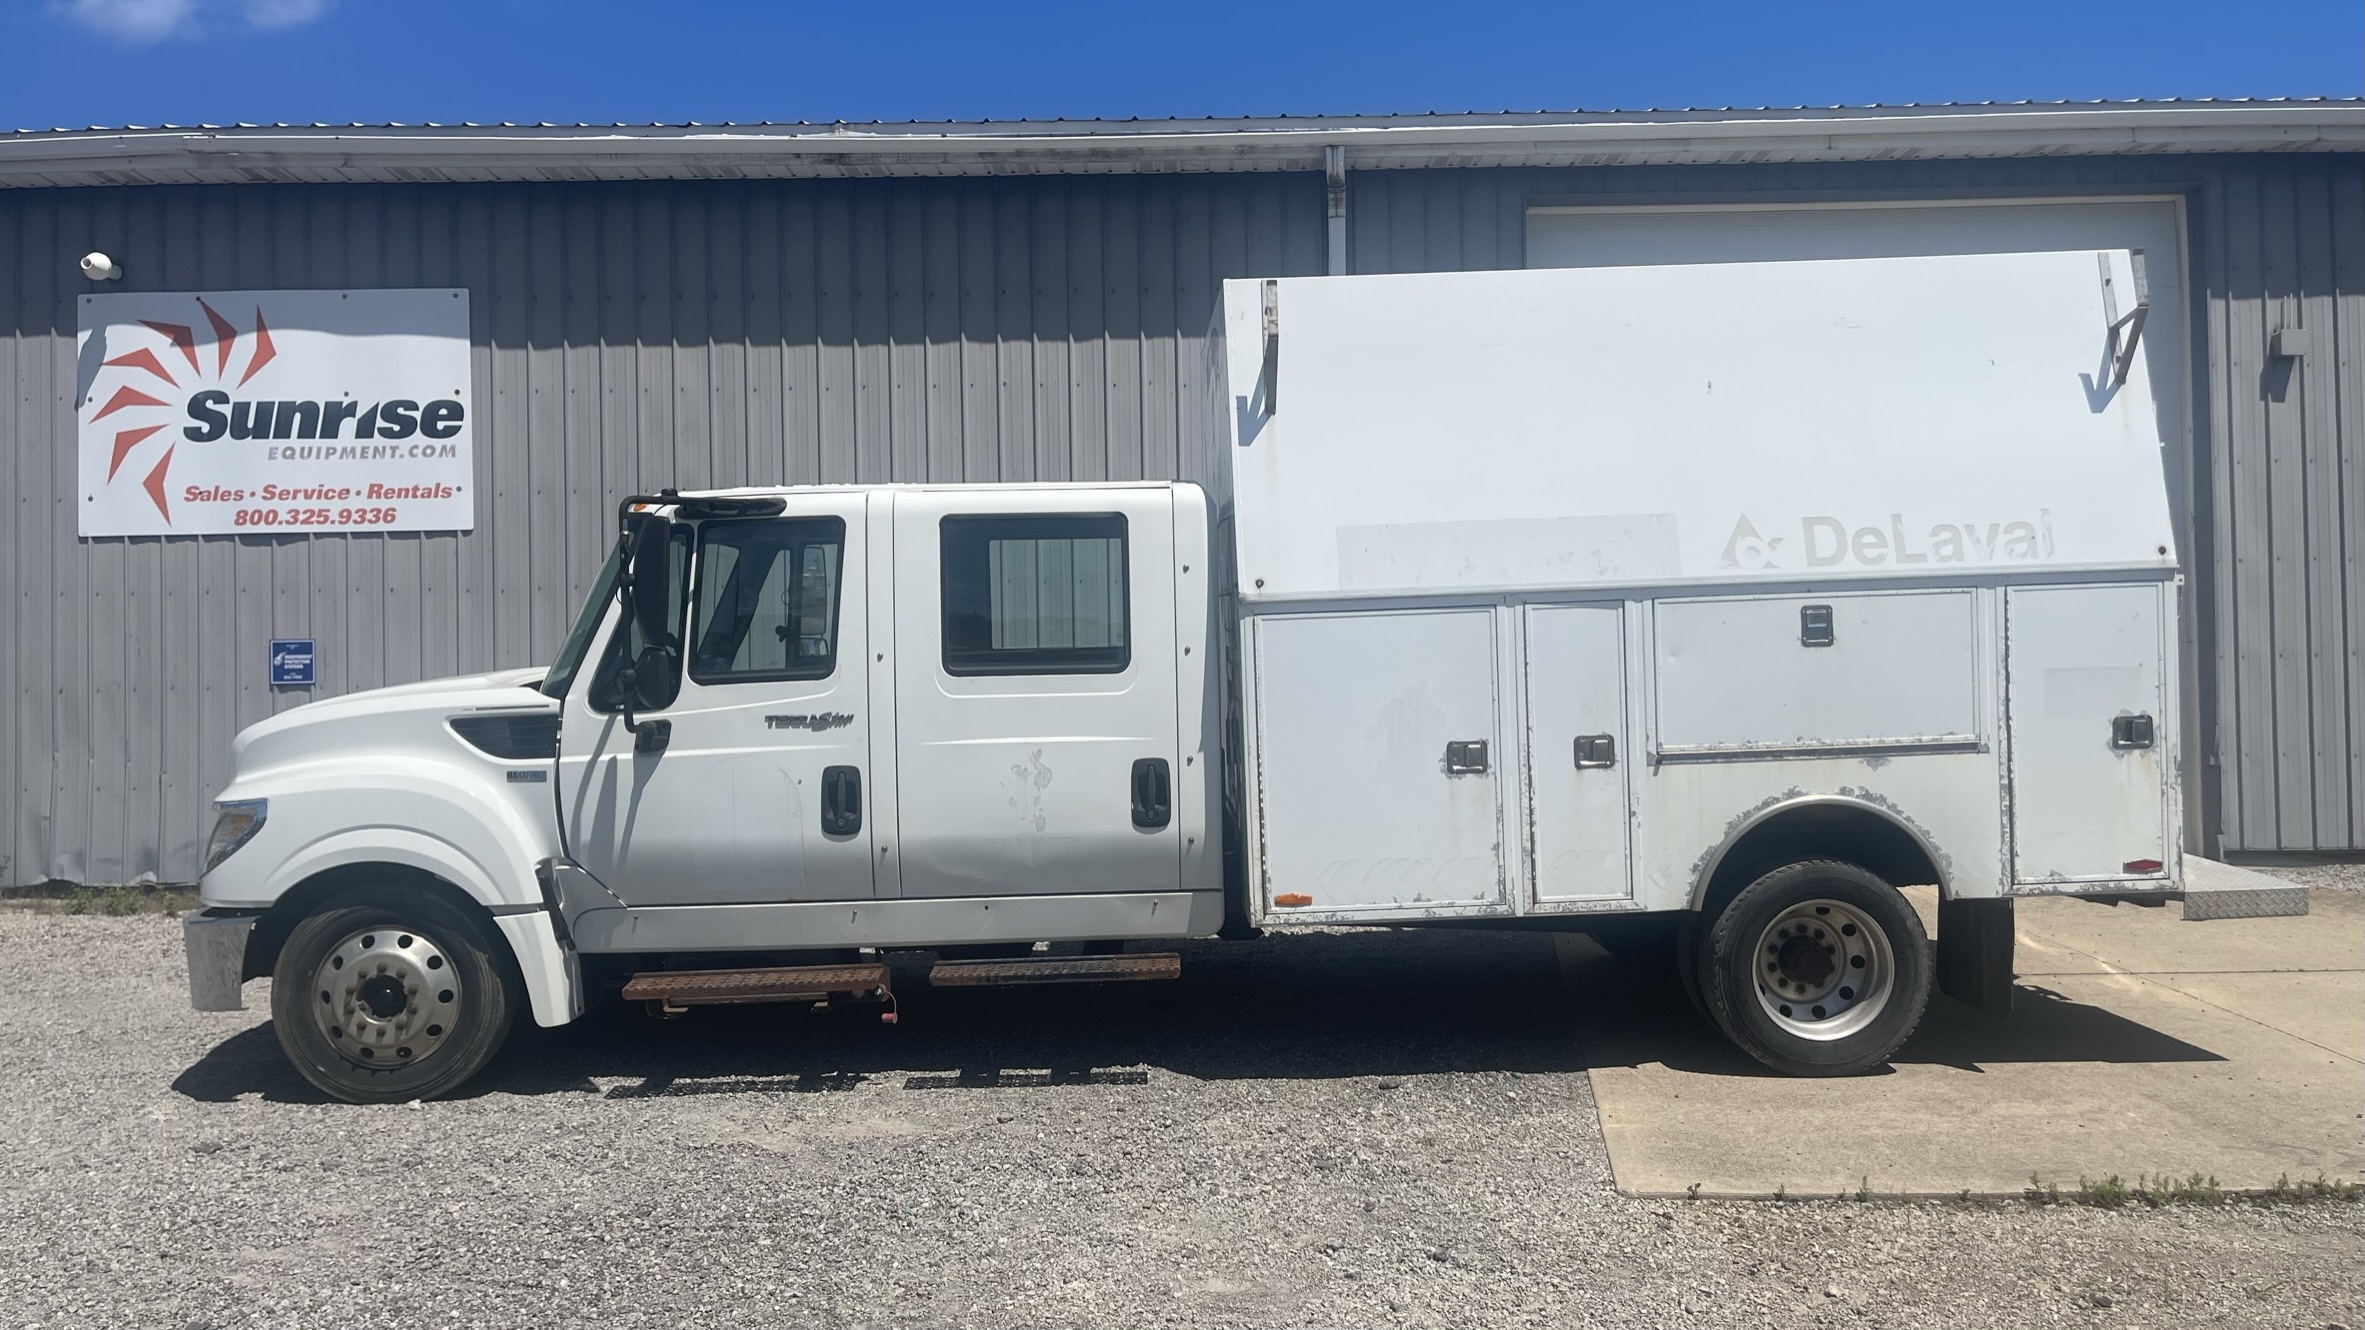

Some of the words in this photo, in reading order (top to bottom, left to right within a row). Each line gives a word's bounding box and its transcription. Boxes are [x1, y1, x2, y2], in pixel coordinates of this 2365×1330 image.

[183, 389, 464, 443] Sunrise
[267, 444, 457, 461] EQUIPMENT.COM
[184, 485, 245, 502] Sales
[261, 484, 350, 501] Service
[367, 482, 453, 500] Rentals
[233, 507, 397, 526] 800.325.9336
[1801, 508, 2055, 568] DeLaval
